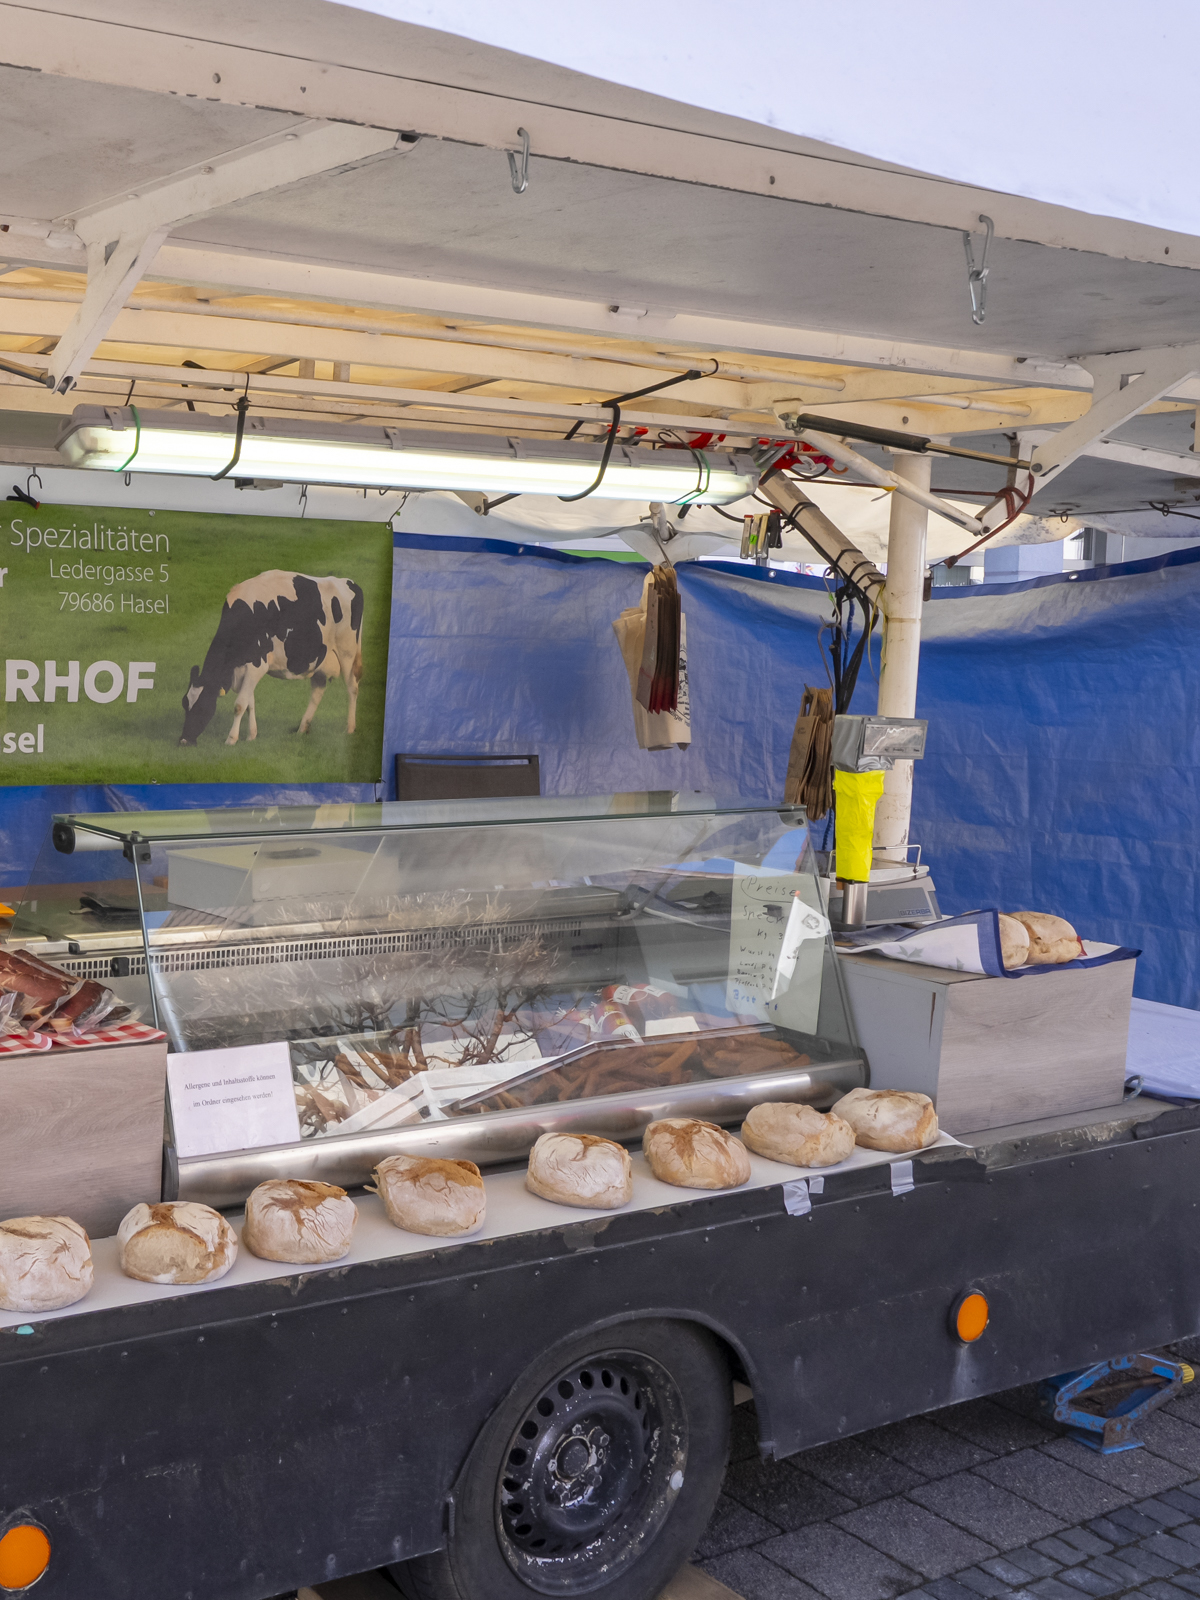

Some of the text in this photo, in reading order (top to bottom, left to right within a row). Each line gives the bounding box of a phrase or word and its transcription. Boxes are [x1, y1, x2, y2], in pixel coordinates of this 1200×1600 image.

[10, 518, 170, 553] Spezialitäten
[49, 558, 169, 586] Ledergasse 5
[58, 591, 169, 614] 79686 Hasel
[746, 875, 797, 897] Preise
[184, 1082, 211, 1090] Allergene
[223, 1076, 256, 1085] Inhaltsstoffe
[256, 1073, 276, 1081] können
[201, 1097, 221, 1106] Ordner
[222, 1095, 252, 1104] eingesehen
[252, 1091, 274, 1099] werden!
